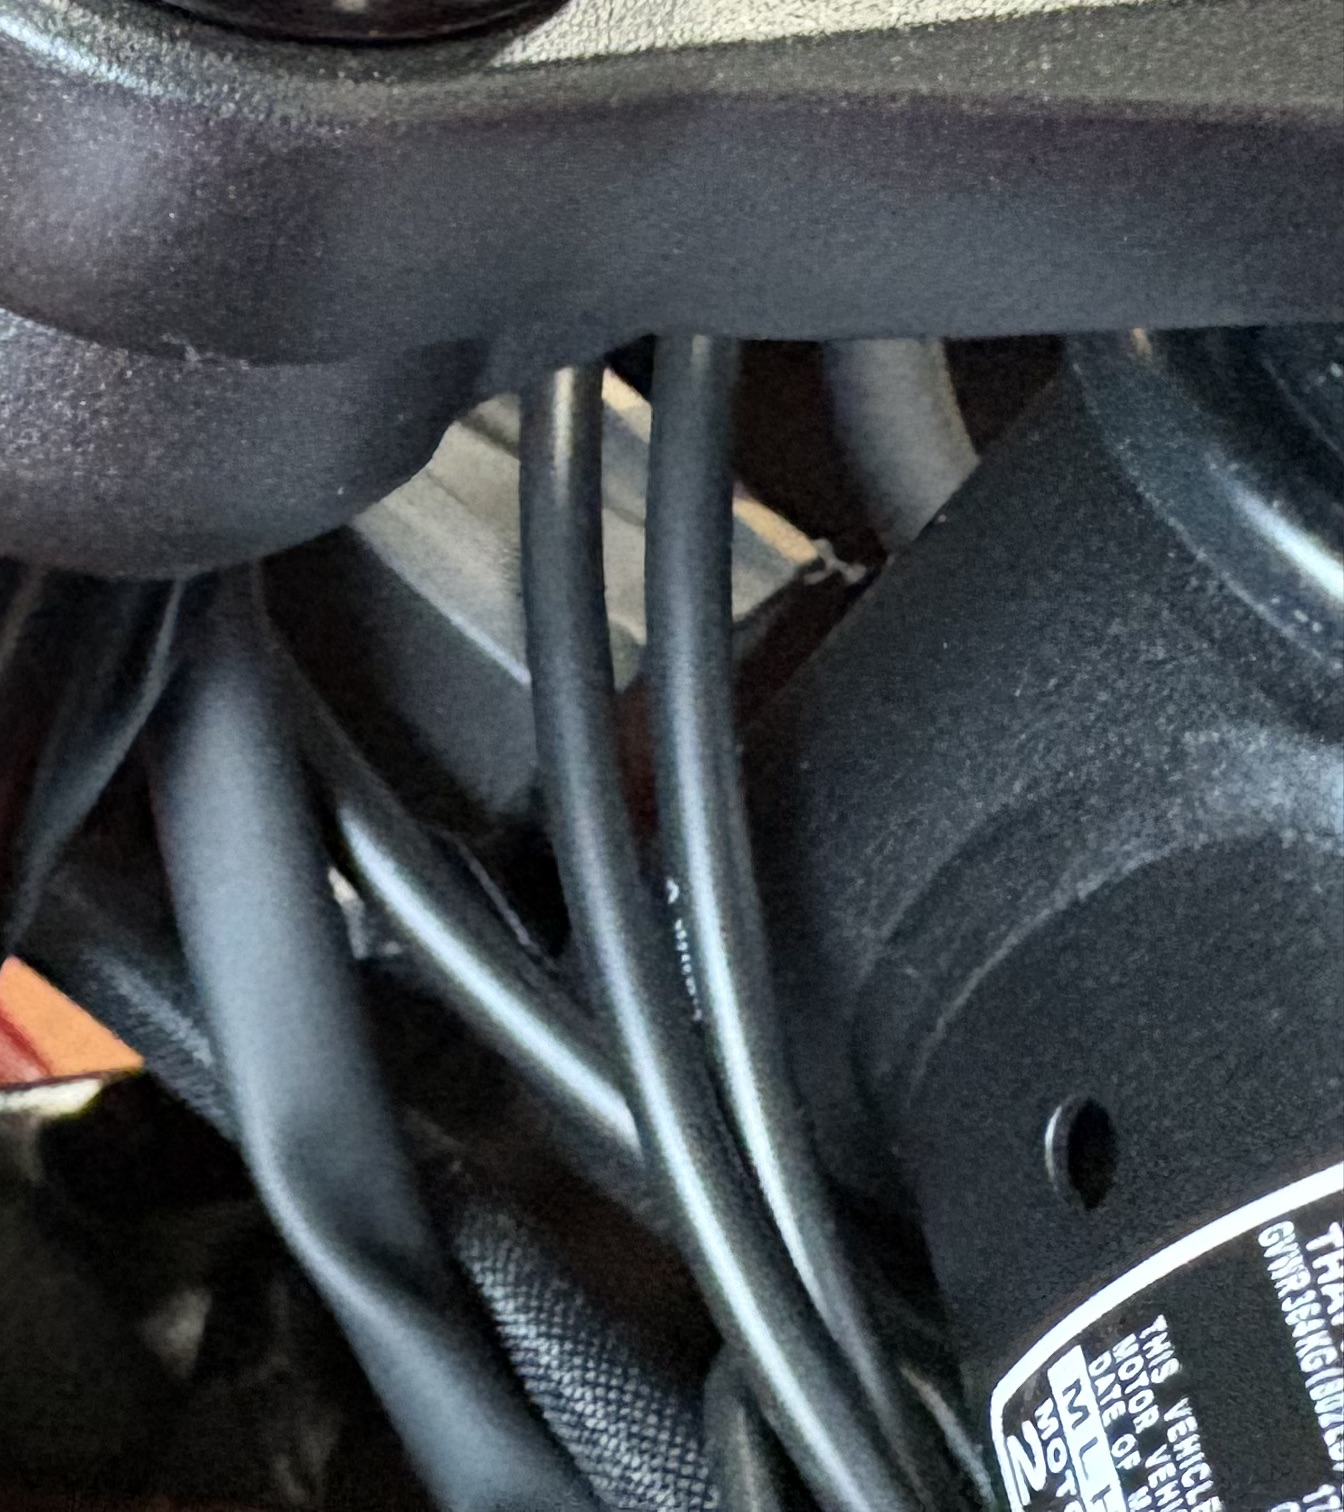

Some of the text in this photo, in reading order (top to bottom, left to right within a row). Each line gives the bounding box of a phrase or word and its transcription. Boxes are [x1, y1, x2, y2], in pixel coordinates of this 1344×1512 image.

[1139, 1314, 1183, 1384] THIS
[1088, 1350, 1126, 1427] DATE
[1111, 1433, 1142, 1471] OF
[1112, 1332, 1188, 1512] MOTOR VEHI
